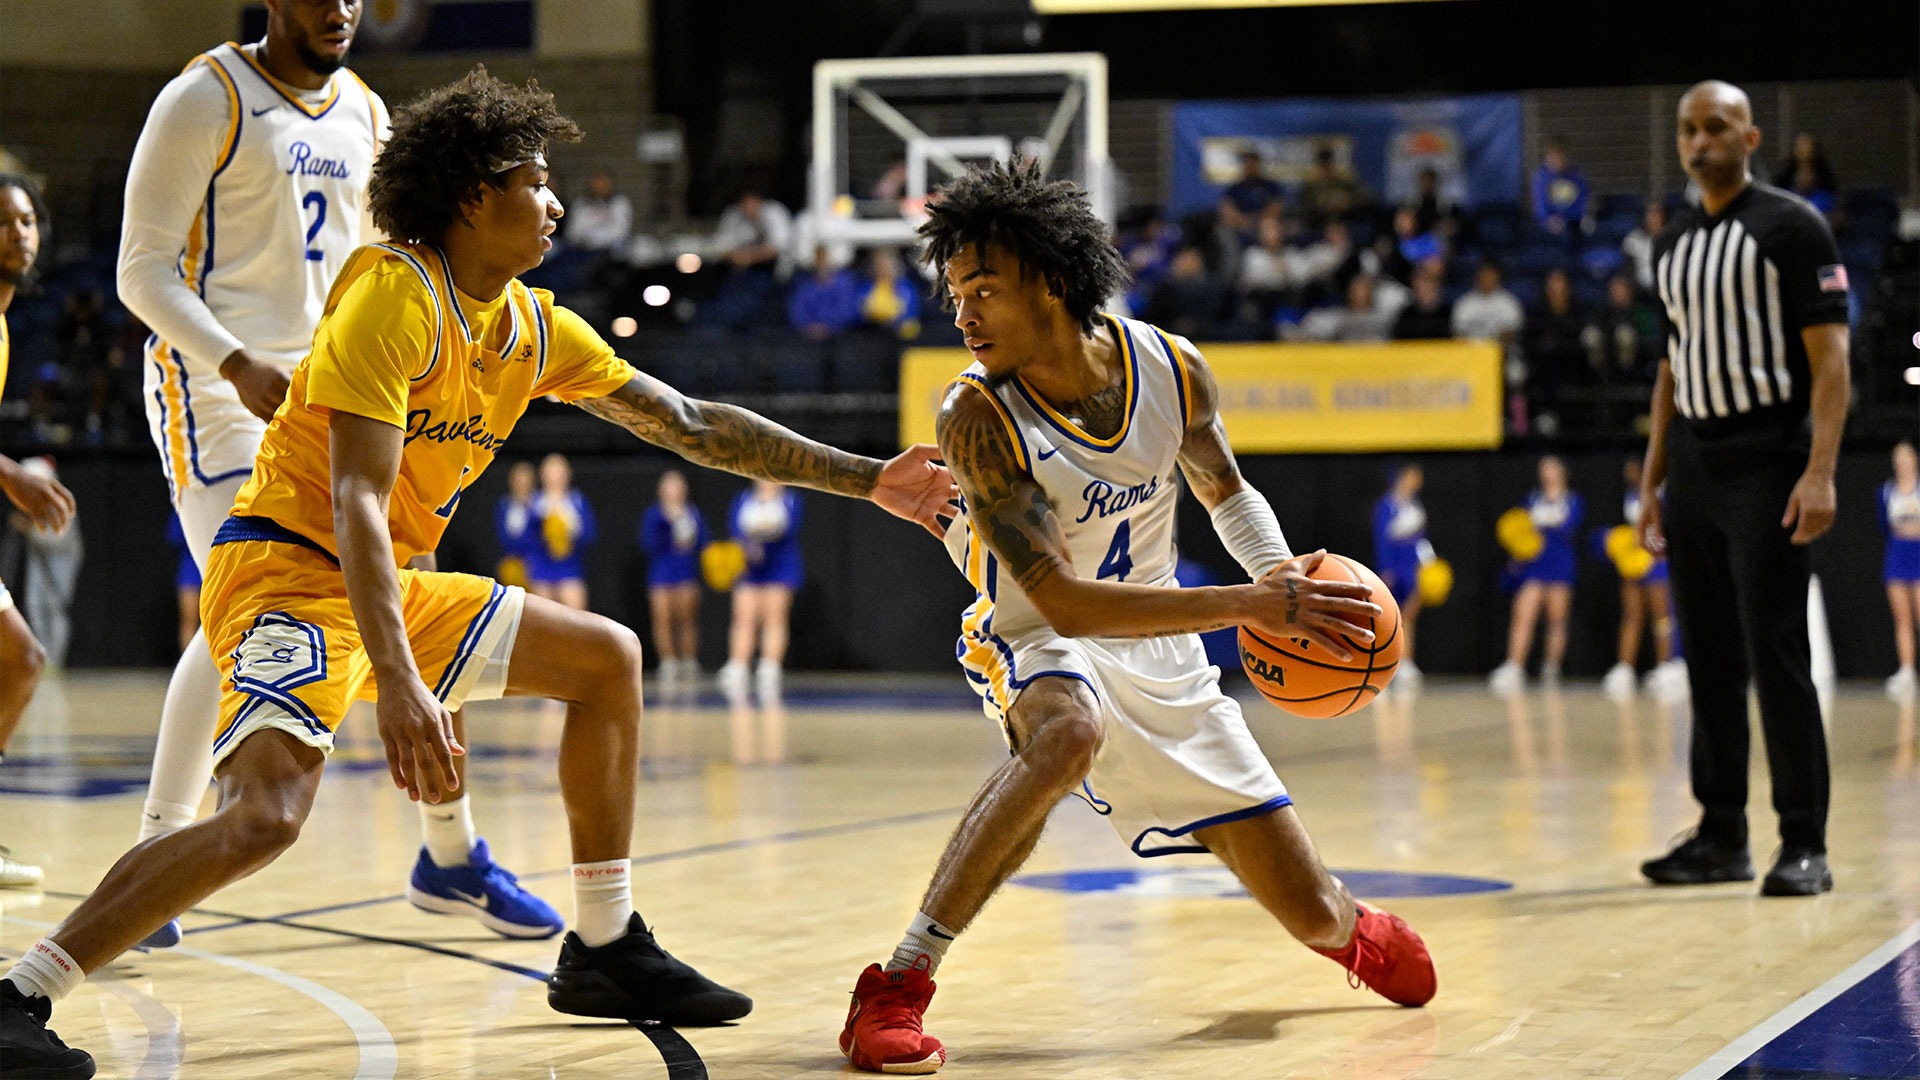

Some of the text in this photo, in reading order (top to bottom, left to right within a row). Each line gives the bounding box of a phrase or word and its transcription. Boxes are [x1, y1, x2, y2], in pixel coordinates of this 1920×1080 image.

[286, 141, 350, 178] Rams
[303, 190, 327, 261] 2
[1076, 475, 1161, 524] Rams
[1096, 517, 1134, 582] 4
[34, 942, 71, 973] upreme
